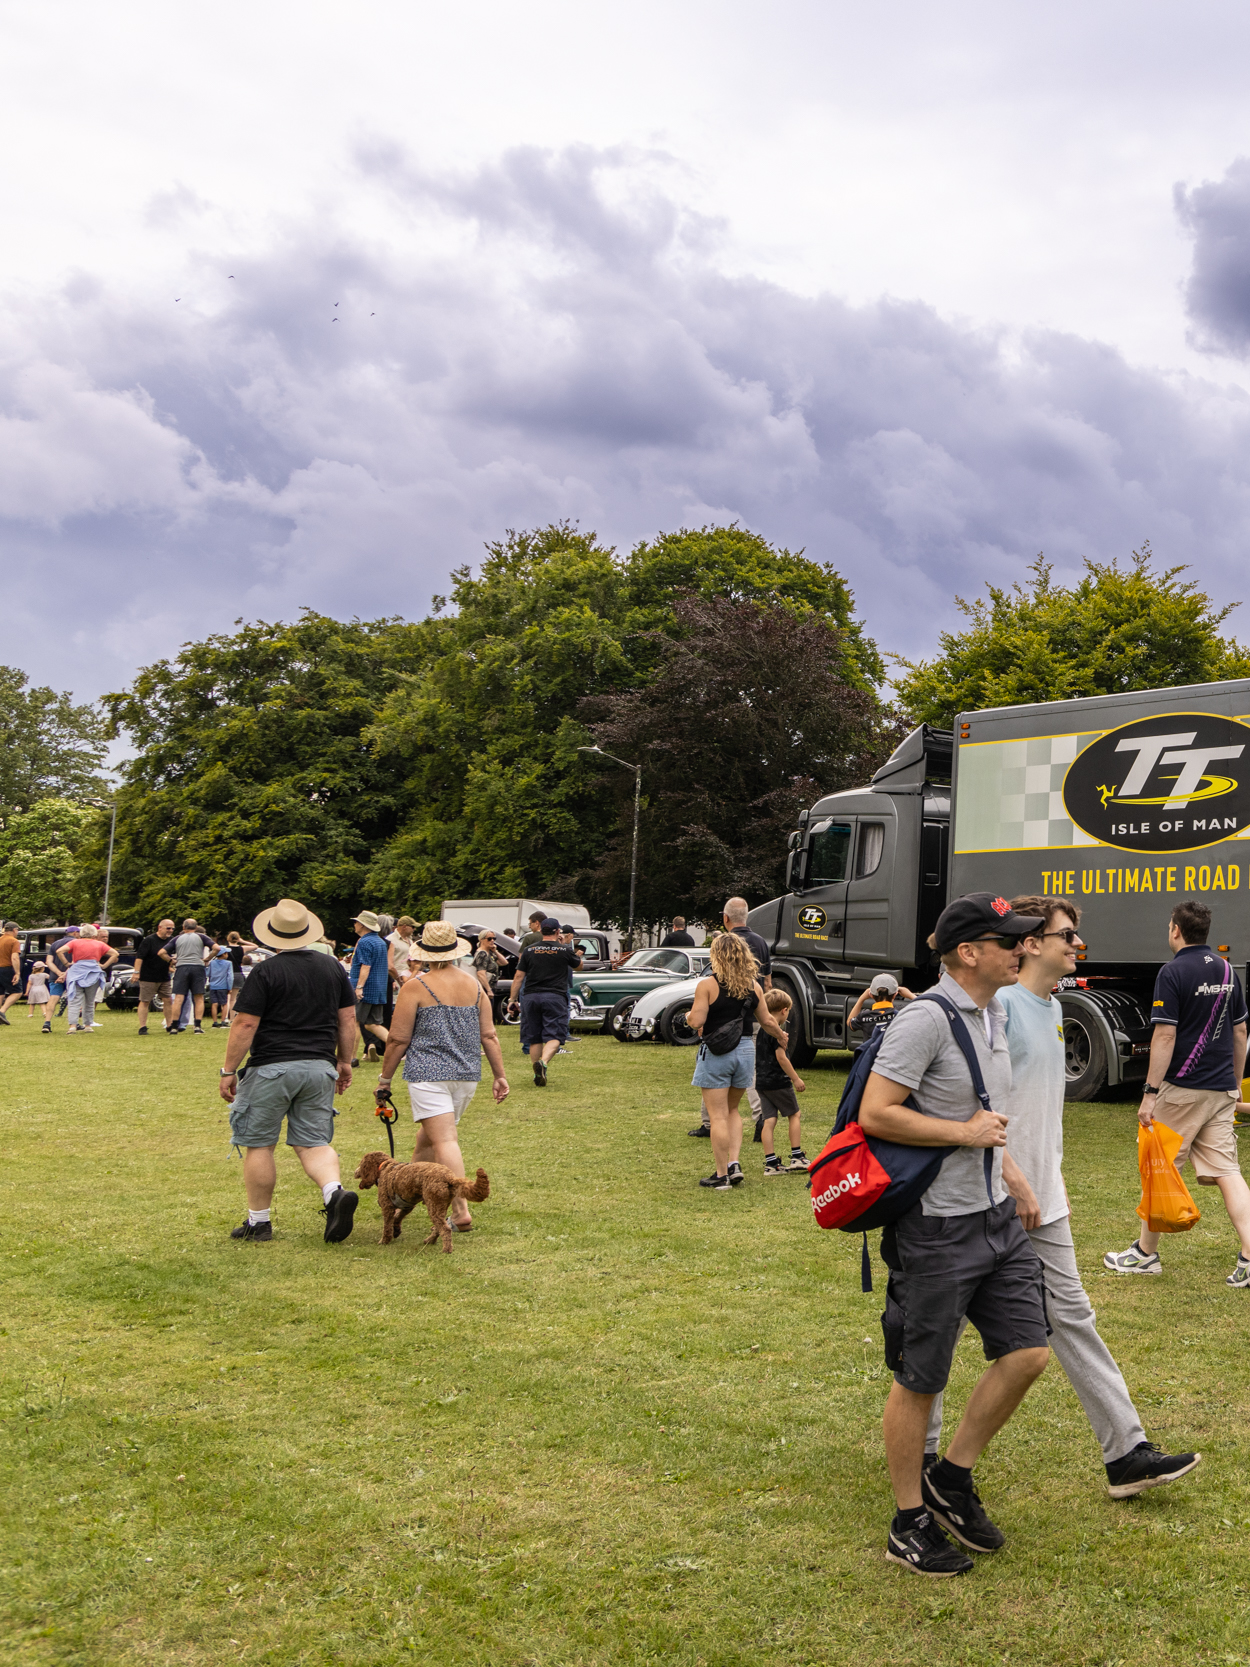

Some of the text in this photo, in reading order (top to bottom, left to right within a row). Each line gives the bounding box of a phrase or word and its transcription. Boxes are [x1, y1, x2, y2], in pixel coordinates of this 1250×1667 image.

[1114, 732, 1246, 810] TT
[1111, 817, 1237, 835] ISLE OF MAN
[1042, 870, 1075, 895] THE
[1082, 866, 1177, 894] ULTIMATE
[1184, 864, 1240, 892] ROAD
[812, 1172, 862, 1212] Reebok
